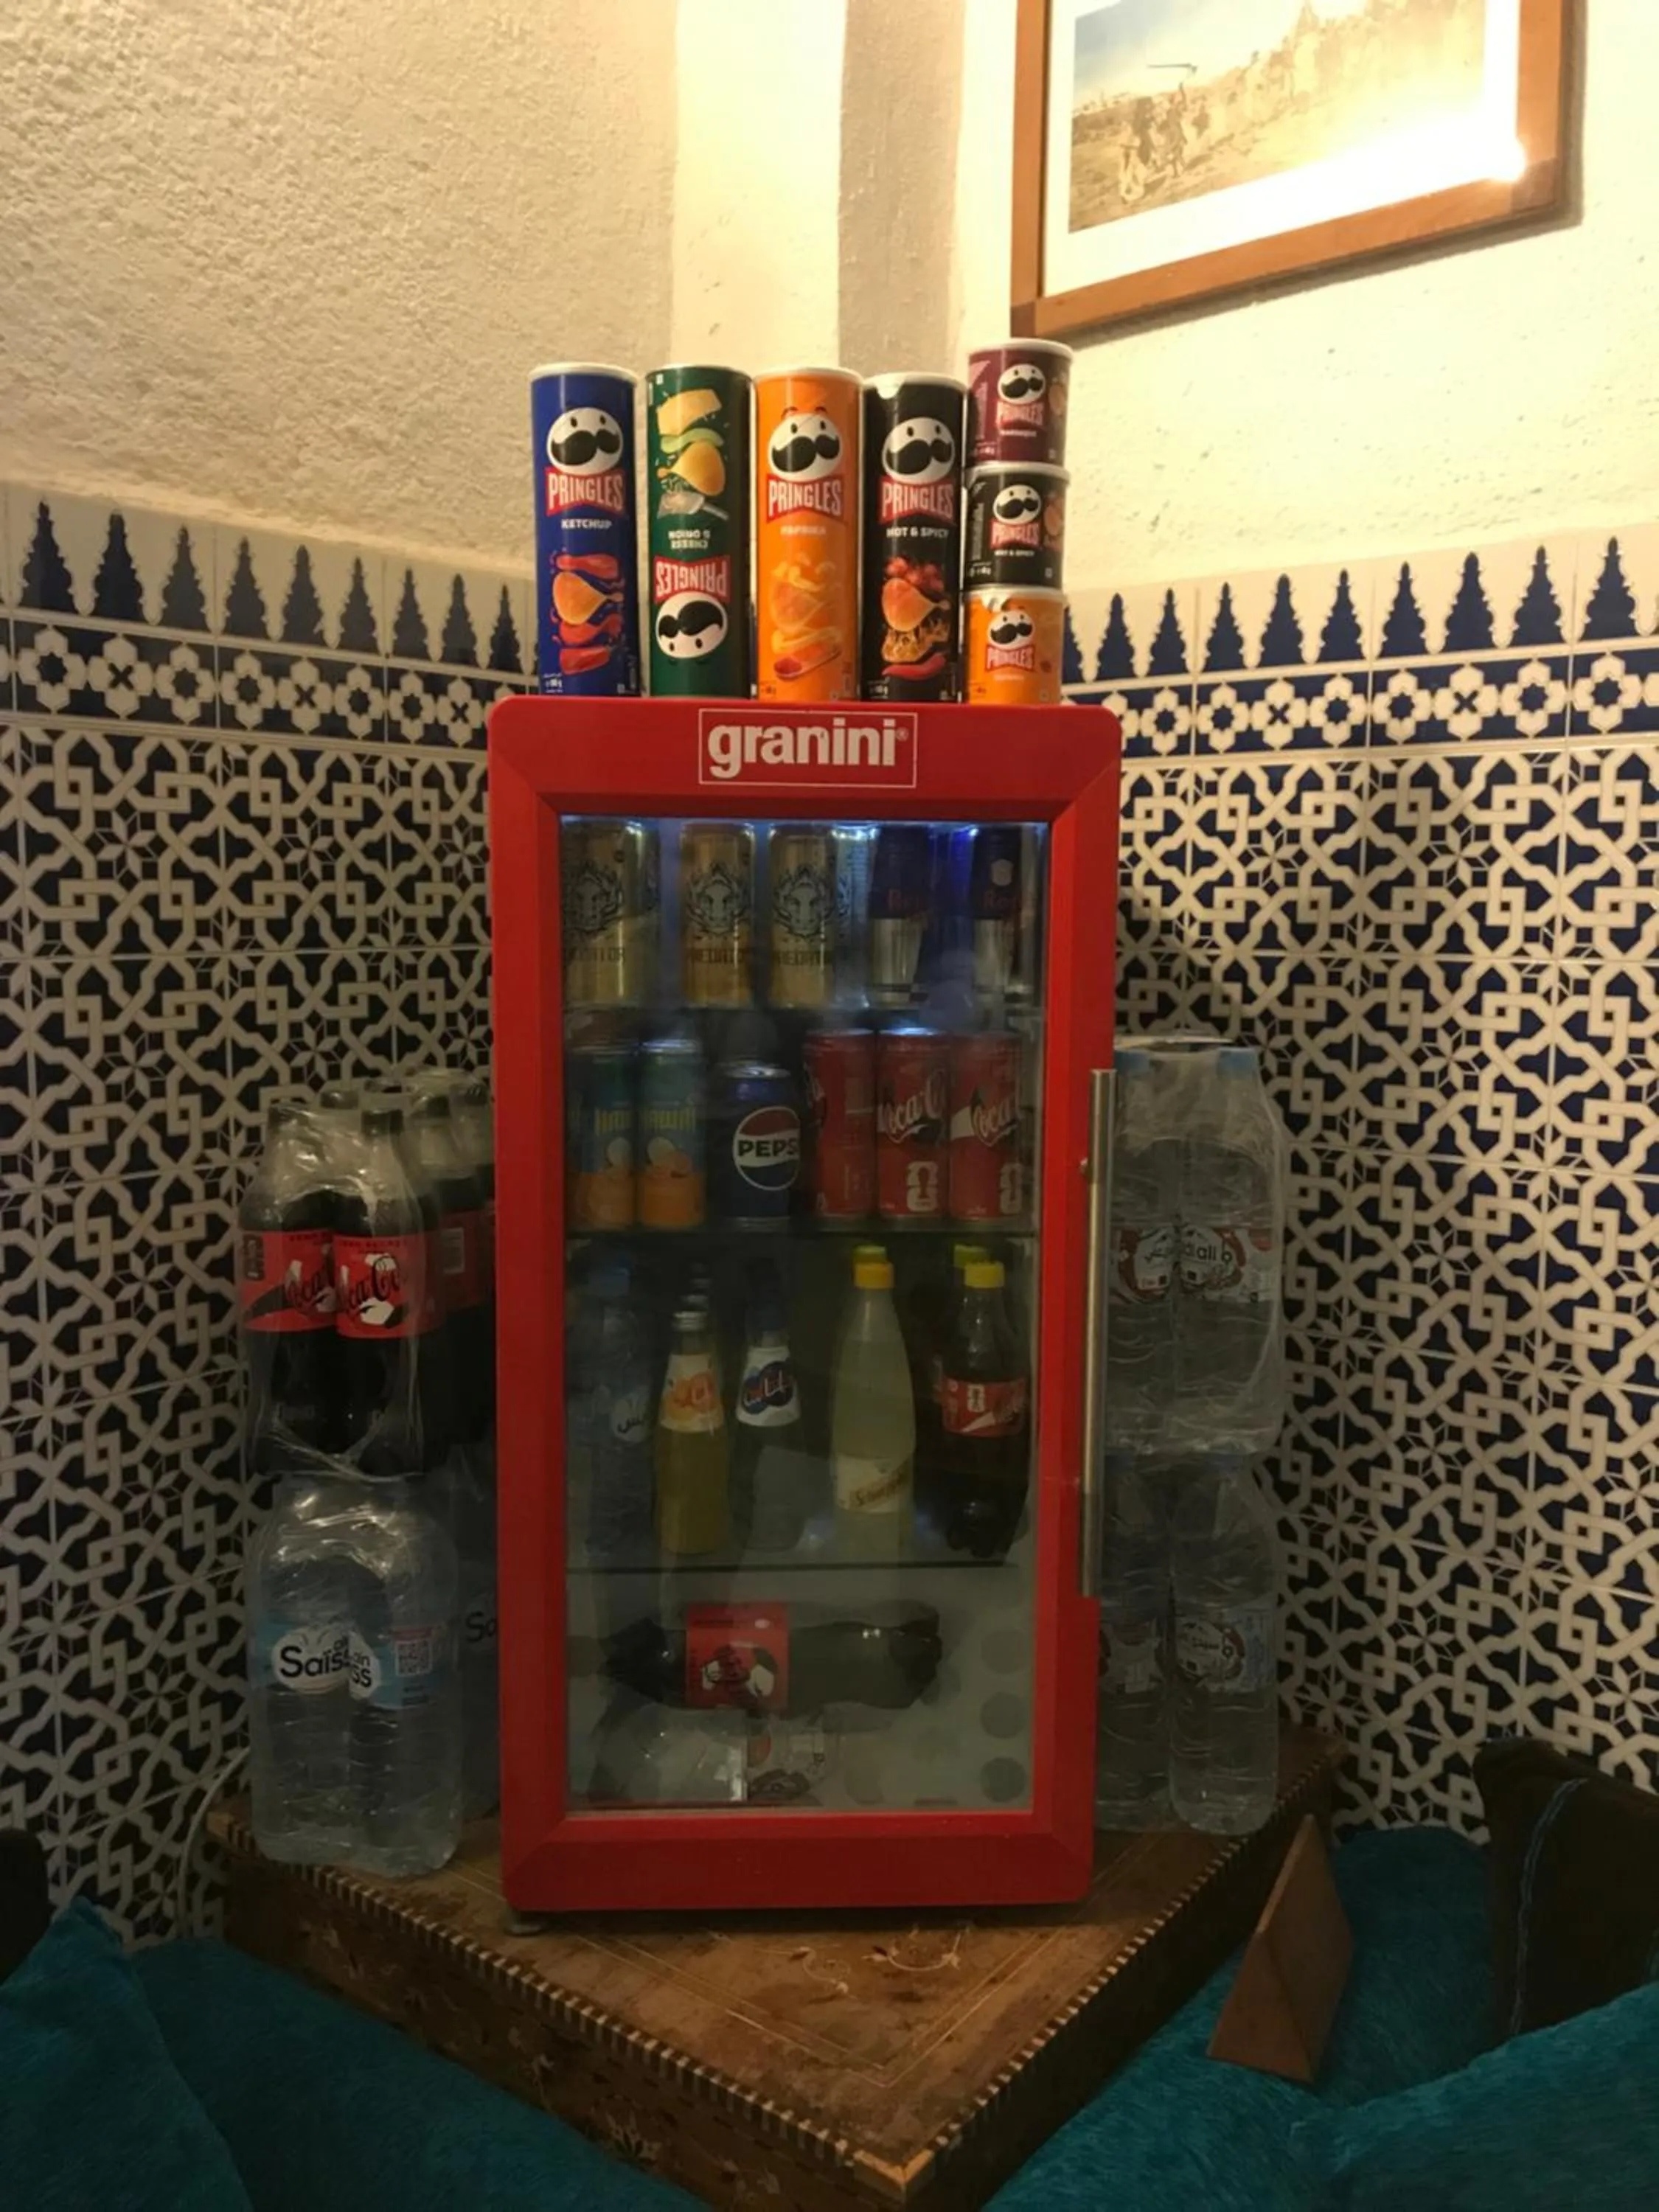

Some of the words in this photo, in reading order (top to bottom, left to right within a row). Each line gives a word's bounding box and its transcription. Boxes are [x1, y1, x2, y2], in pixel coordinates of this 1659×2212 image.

[995, 402, 1045, 426] PRINGLES
[548, 472, 623, 510] PRINGLES
[768, 480, 841, 518] PRINGLES
[881, 483, 954, 519] PRINGLES
[561, 519, 612, 529] KETCHUP
[886, 526, 908, 538] HOT
[919, 528, 950, 539] SPICY
[992, 521, 1039, 546] PRINGLES
[655, 560, 728, 597] PRINGLES
[987, 647, 1034, 670] PRINGLES
[708, 717, 896, 779] granini
[738, 1139, 801, 1158] PEPS
[466, 1611, 495, 1644] Sa
